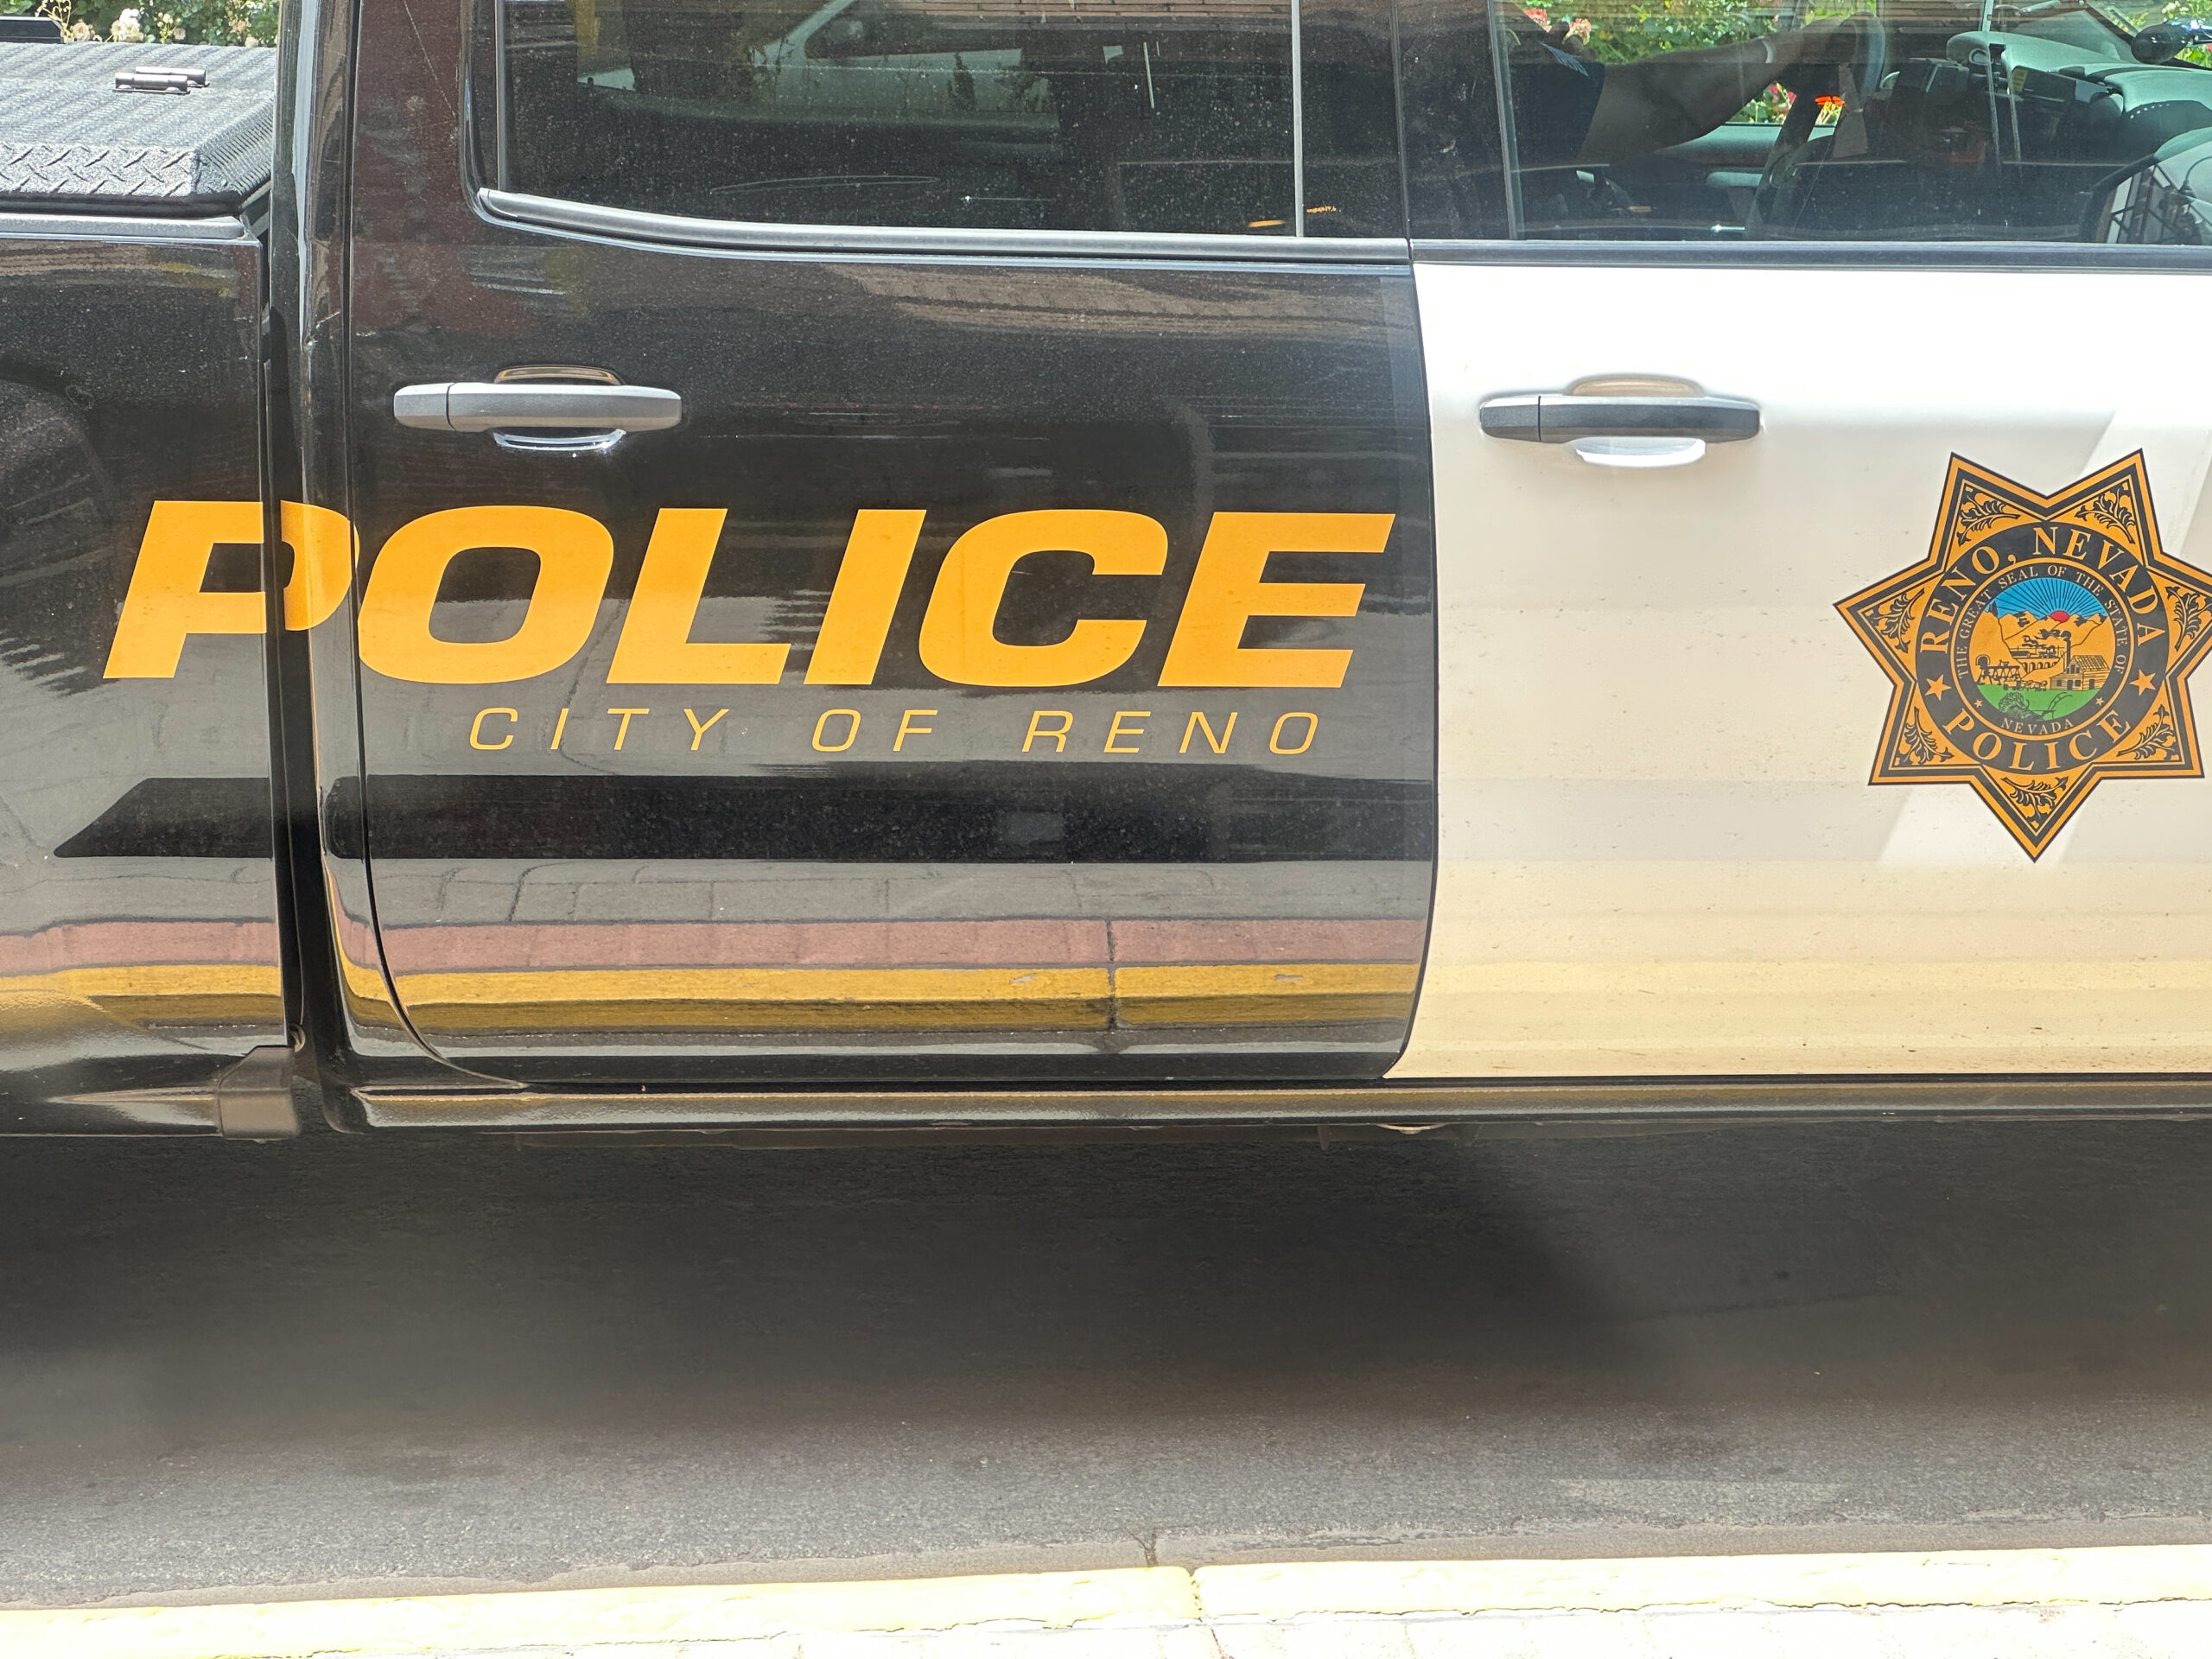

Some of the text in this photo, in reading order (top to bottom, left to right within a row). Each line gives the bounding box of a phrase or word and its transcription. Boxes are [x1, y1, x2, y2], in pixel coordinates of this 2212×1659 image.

[103, 499, 1395, 688] POLICE
[1920, 525, 2166, 655] RENO, NEVADA
[1955, 564, 2127, 679] THE GREAT SEAL OF THE STATE OF
[468, 707, 1320, 755] CITY OF RENO
[1942, 708, 2132, 771] POLICE
[2000, 717, 2075, 735] NEVADA
